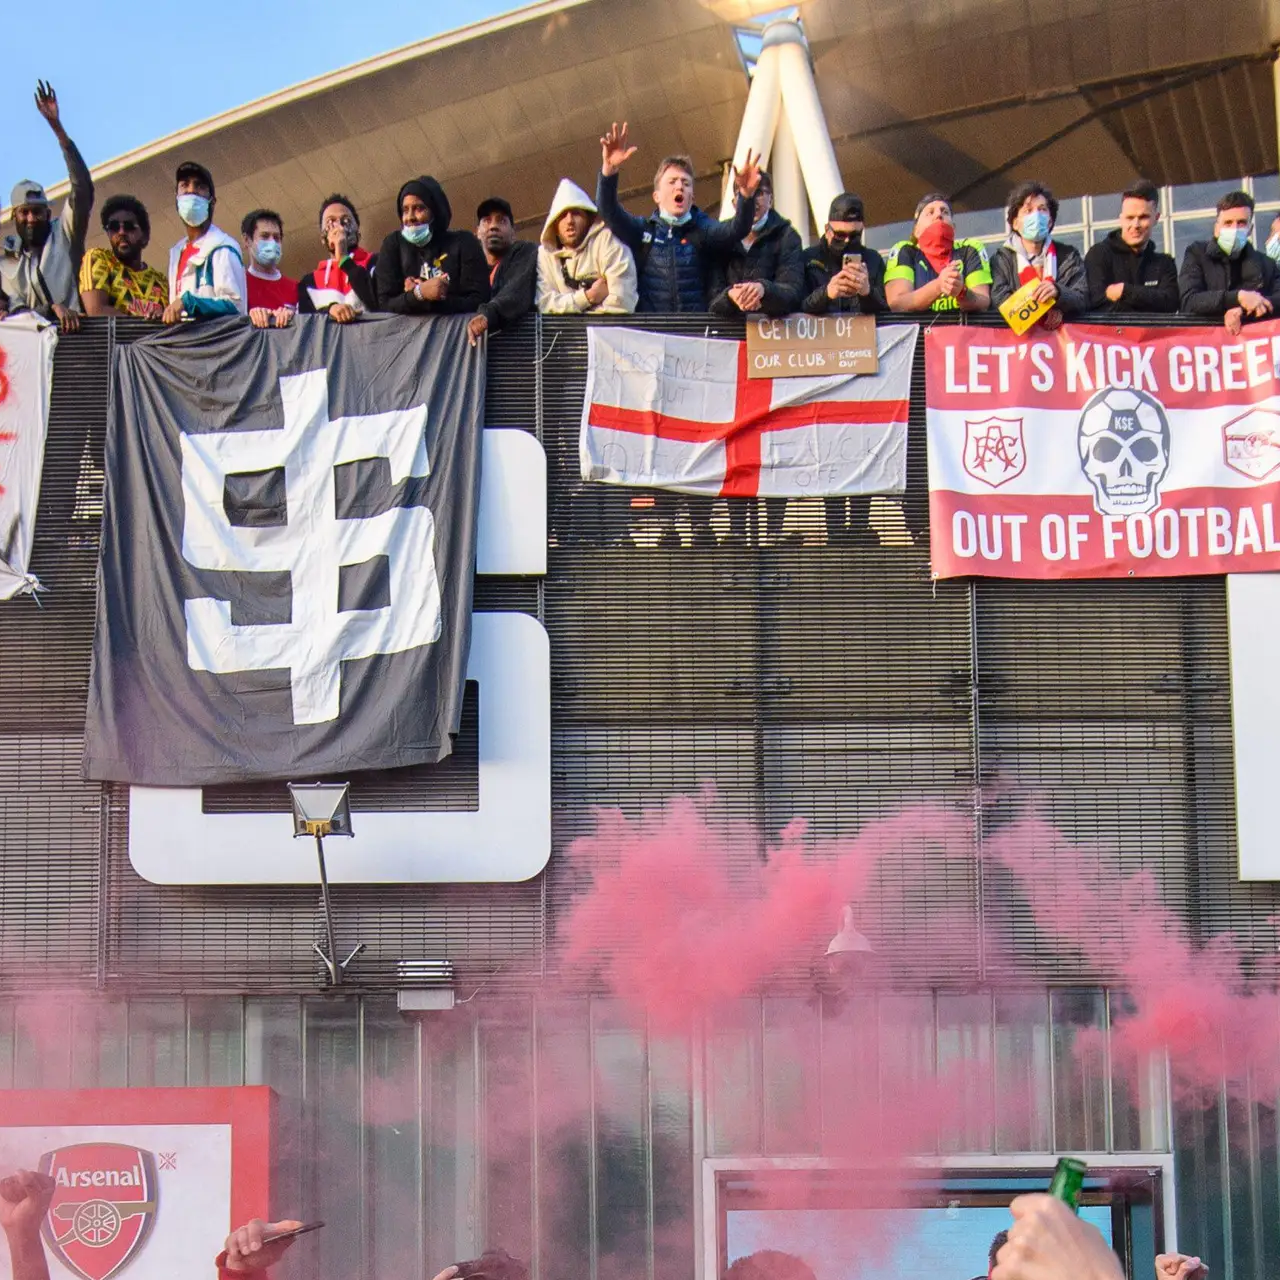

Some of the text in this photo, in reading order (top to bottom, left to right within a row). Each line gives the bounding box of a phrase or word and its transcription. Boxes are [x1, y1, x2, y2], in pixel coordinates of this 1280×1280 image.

[1019, 300, 1039, 321] OU
[758, 317, 791, 340] GET
[797, 316, 828, 340] OUT
[754, 353, 826, 369] OUR CLUB
[945, 344, 1055, 395] LET'S
[1064, 340, 1162, 392] KICK
[769, 436, 878, 470] FUCK
[951, 513, 1029, 563] OUT
[1038, 512, 1090, 562] OF
[56, 1165, 141, 1188] Arsenal
